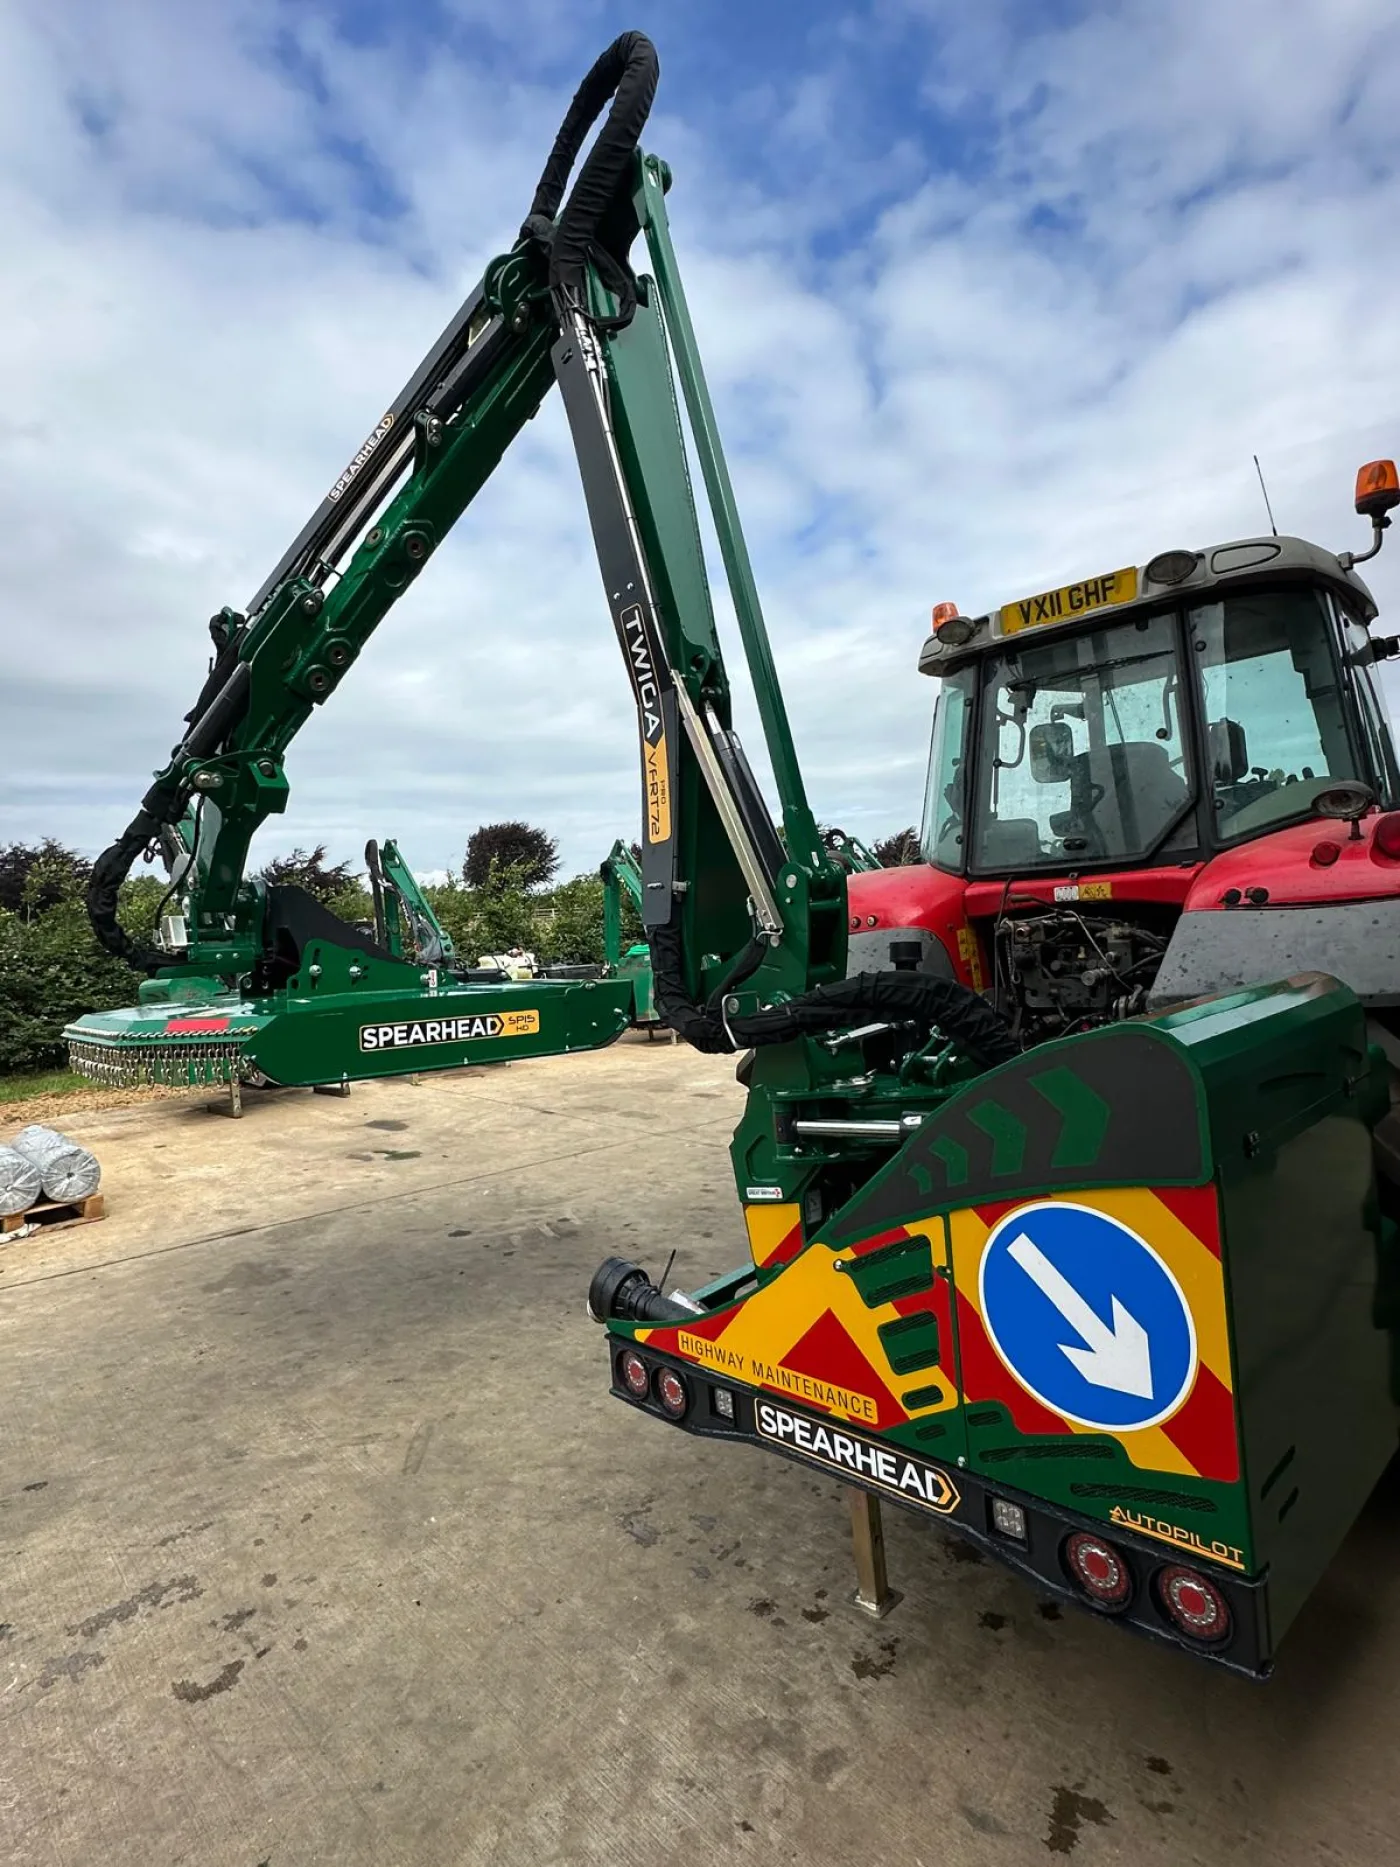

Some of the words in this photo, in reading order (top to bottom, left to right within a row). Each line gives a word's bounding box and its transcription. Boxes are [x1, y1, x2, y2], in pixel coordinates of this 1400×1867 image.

[331, 417, 393, 499] SPEARHEAD
[1019, 592, 1063, 624] VX11
[1069, 575, 1115, 610] GHF
[626, 610, 660, 738] TWIGA
[363, 1016, 503, 1049] SPEARHEAD
[680, 1334, 745, 1371] HIGHWAY
[751, 1360, 874, 1419] MAINTENANCE
[760, 1405, 952, 1505] SPEARHEAD
[1109, 1505, 1244, 1562] AUTOPILOT
